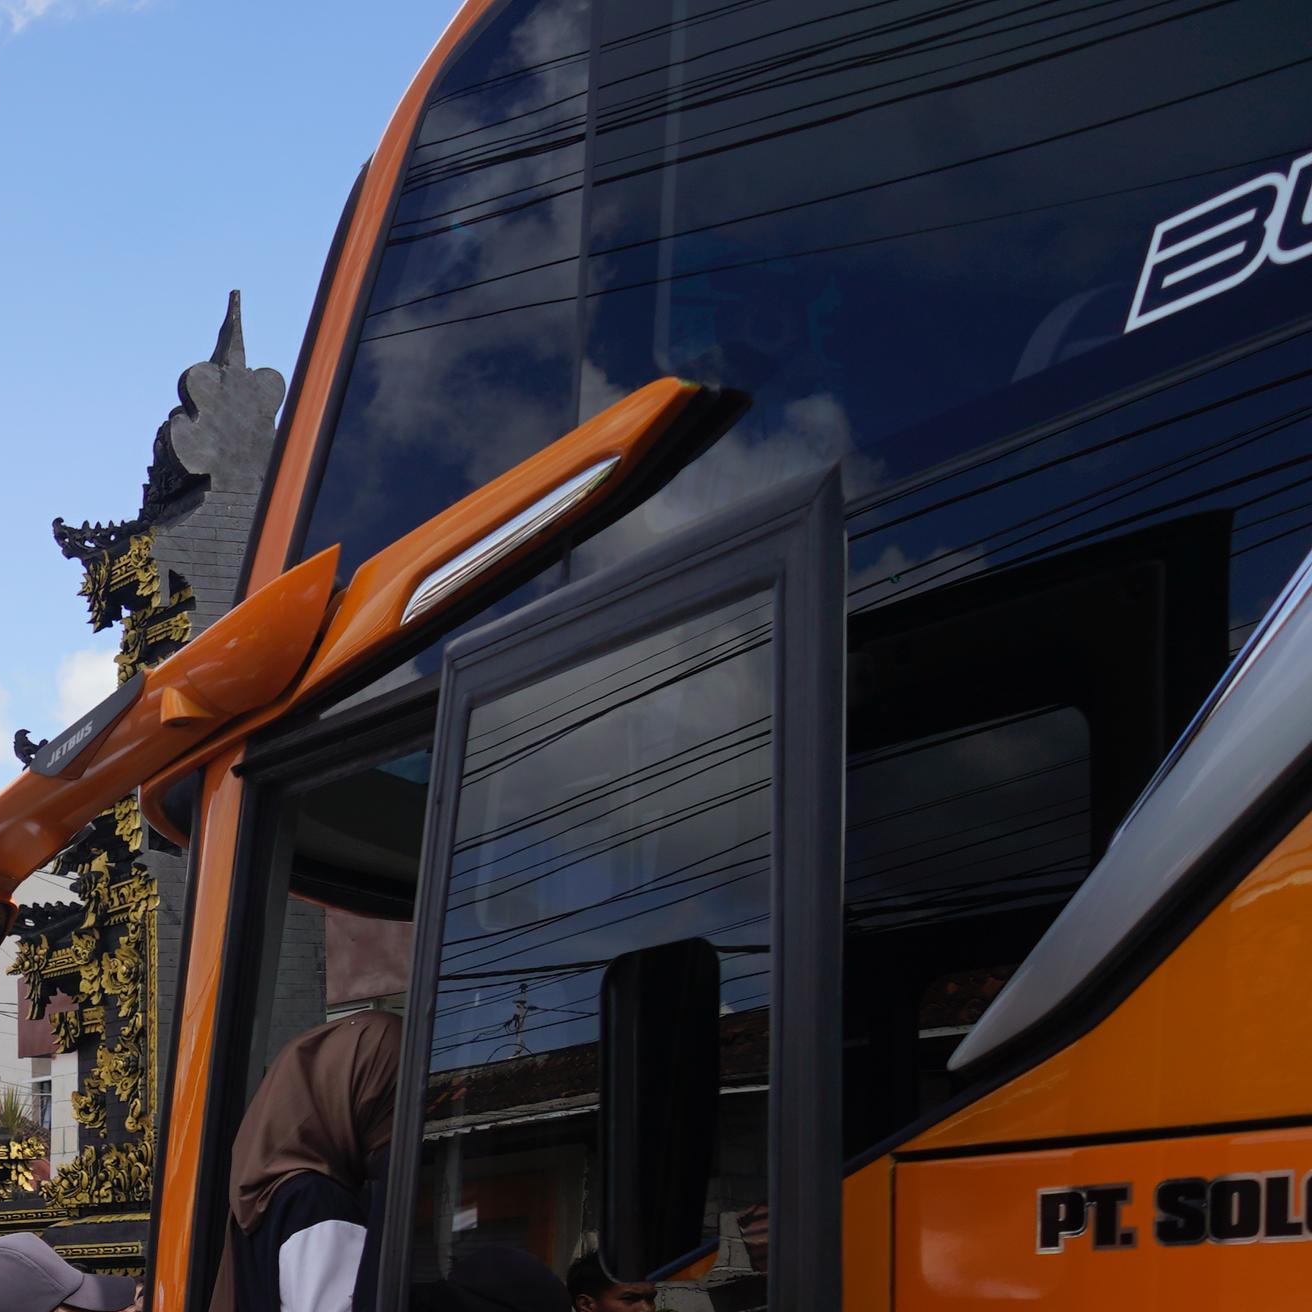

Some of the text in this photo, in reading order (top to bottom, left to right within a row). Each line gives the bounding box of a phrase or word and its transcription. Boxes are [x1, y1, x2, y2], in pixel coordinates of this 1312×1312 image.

[46, 720, 93, 769] JETBUS
[1035, 1168, 1312, 1255] PT. SOL
